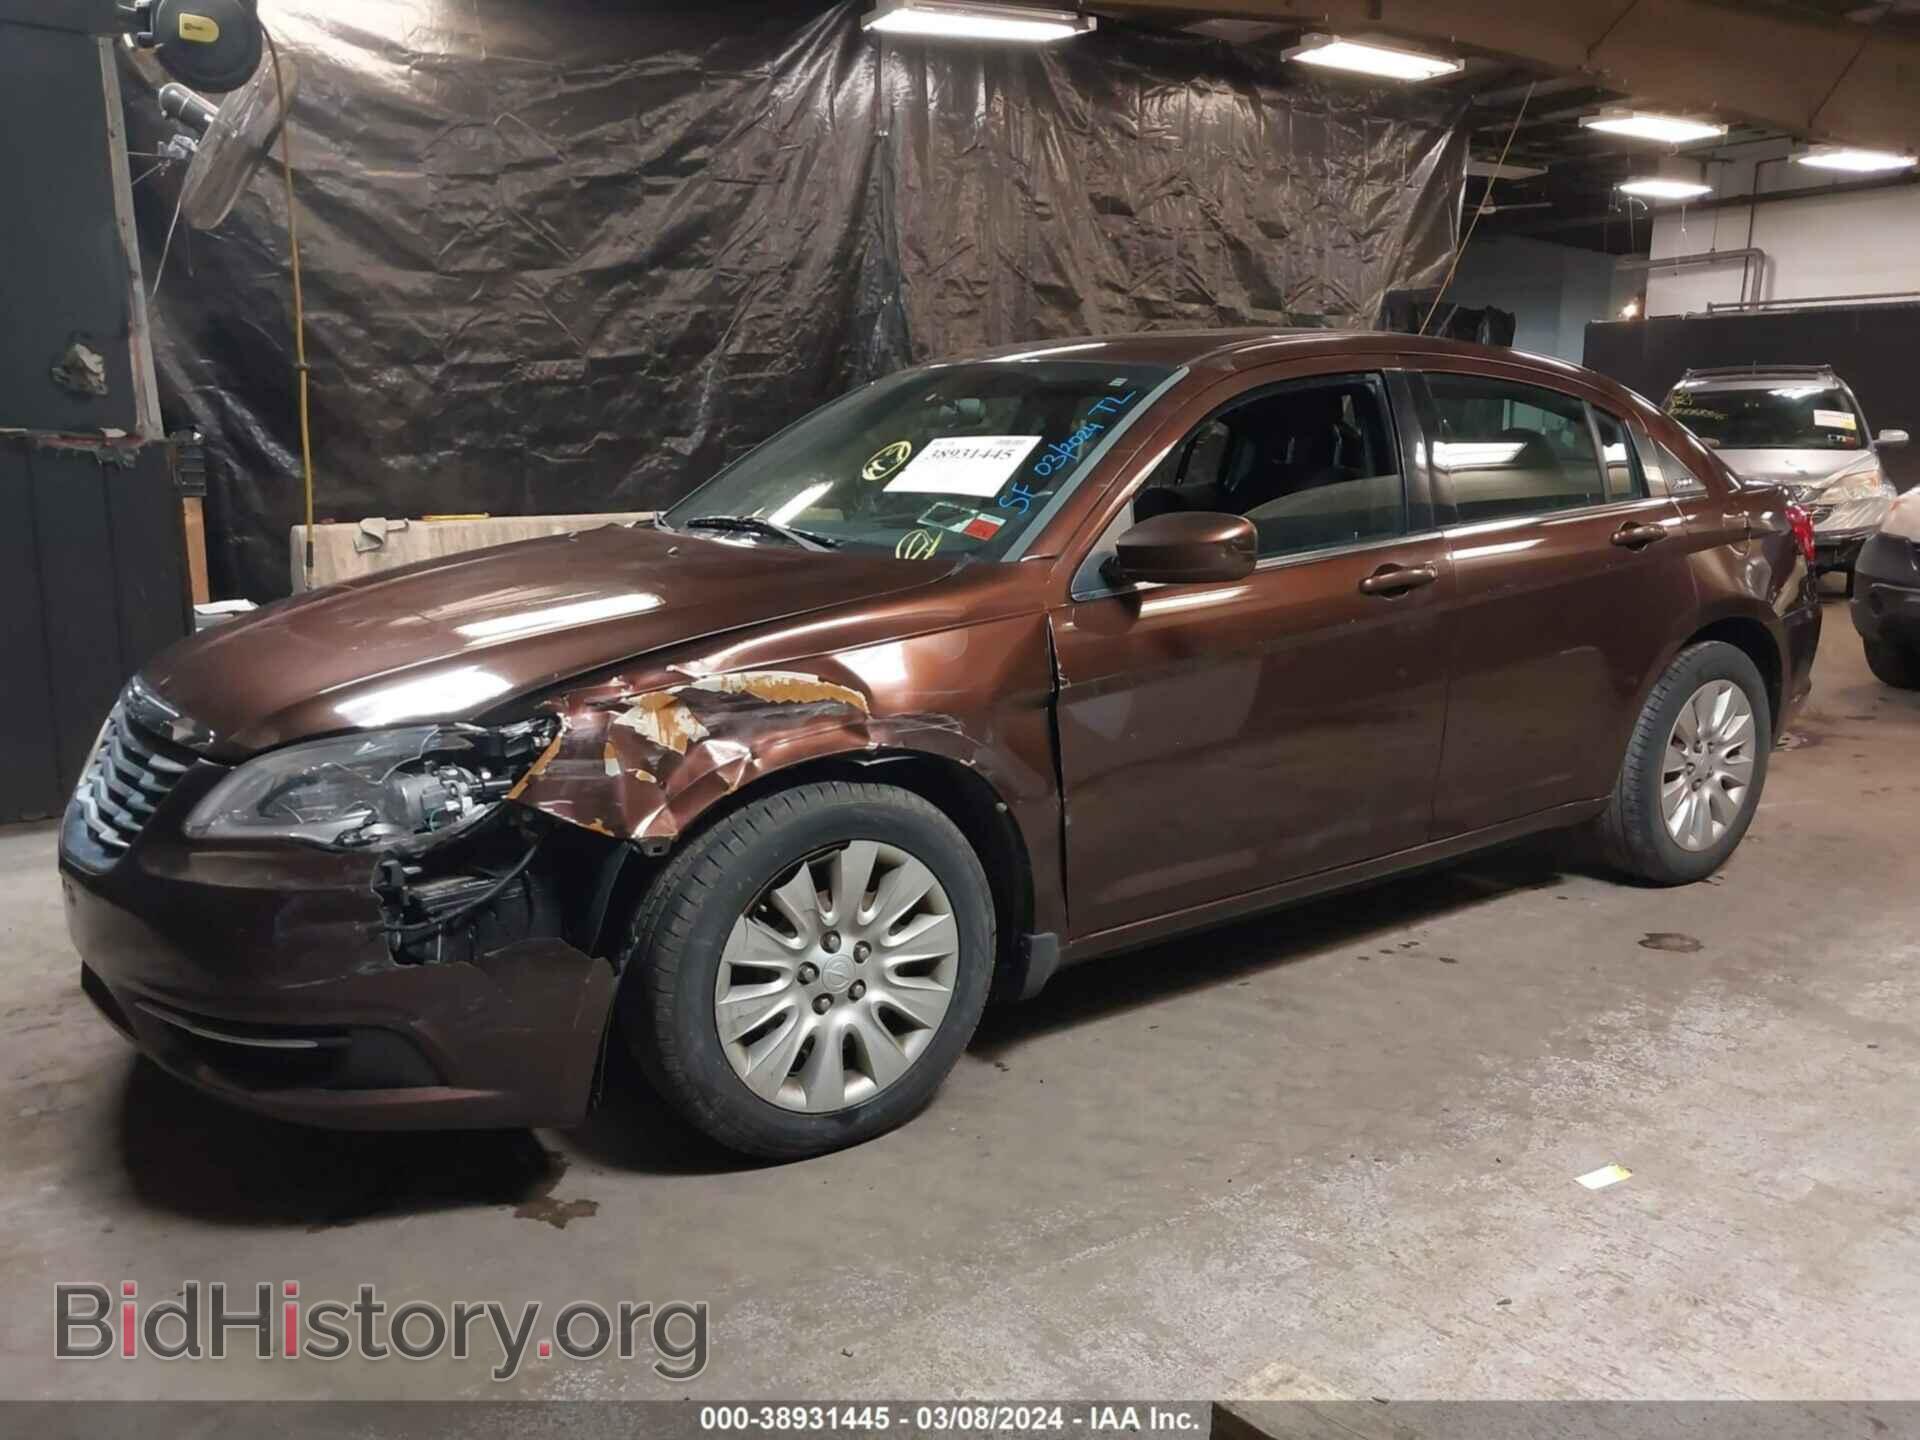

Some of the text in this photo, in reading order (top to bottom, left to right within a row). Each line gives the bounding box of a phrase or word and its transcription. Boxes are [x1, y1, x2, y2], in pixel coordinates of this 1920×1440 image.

[998, 390, 1137, 515] SF 03/2024 TL
